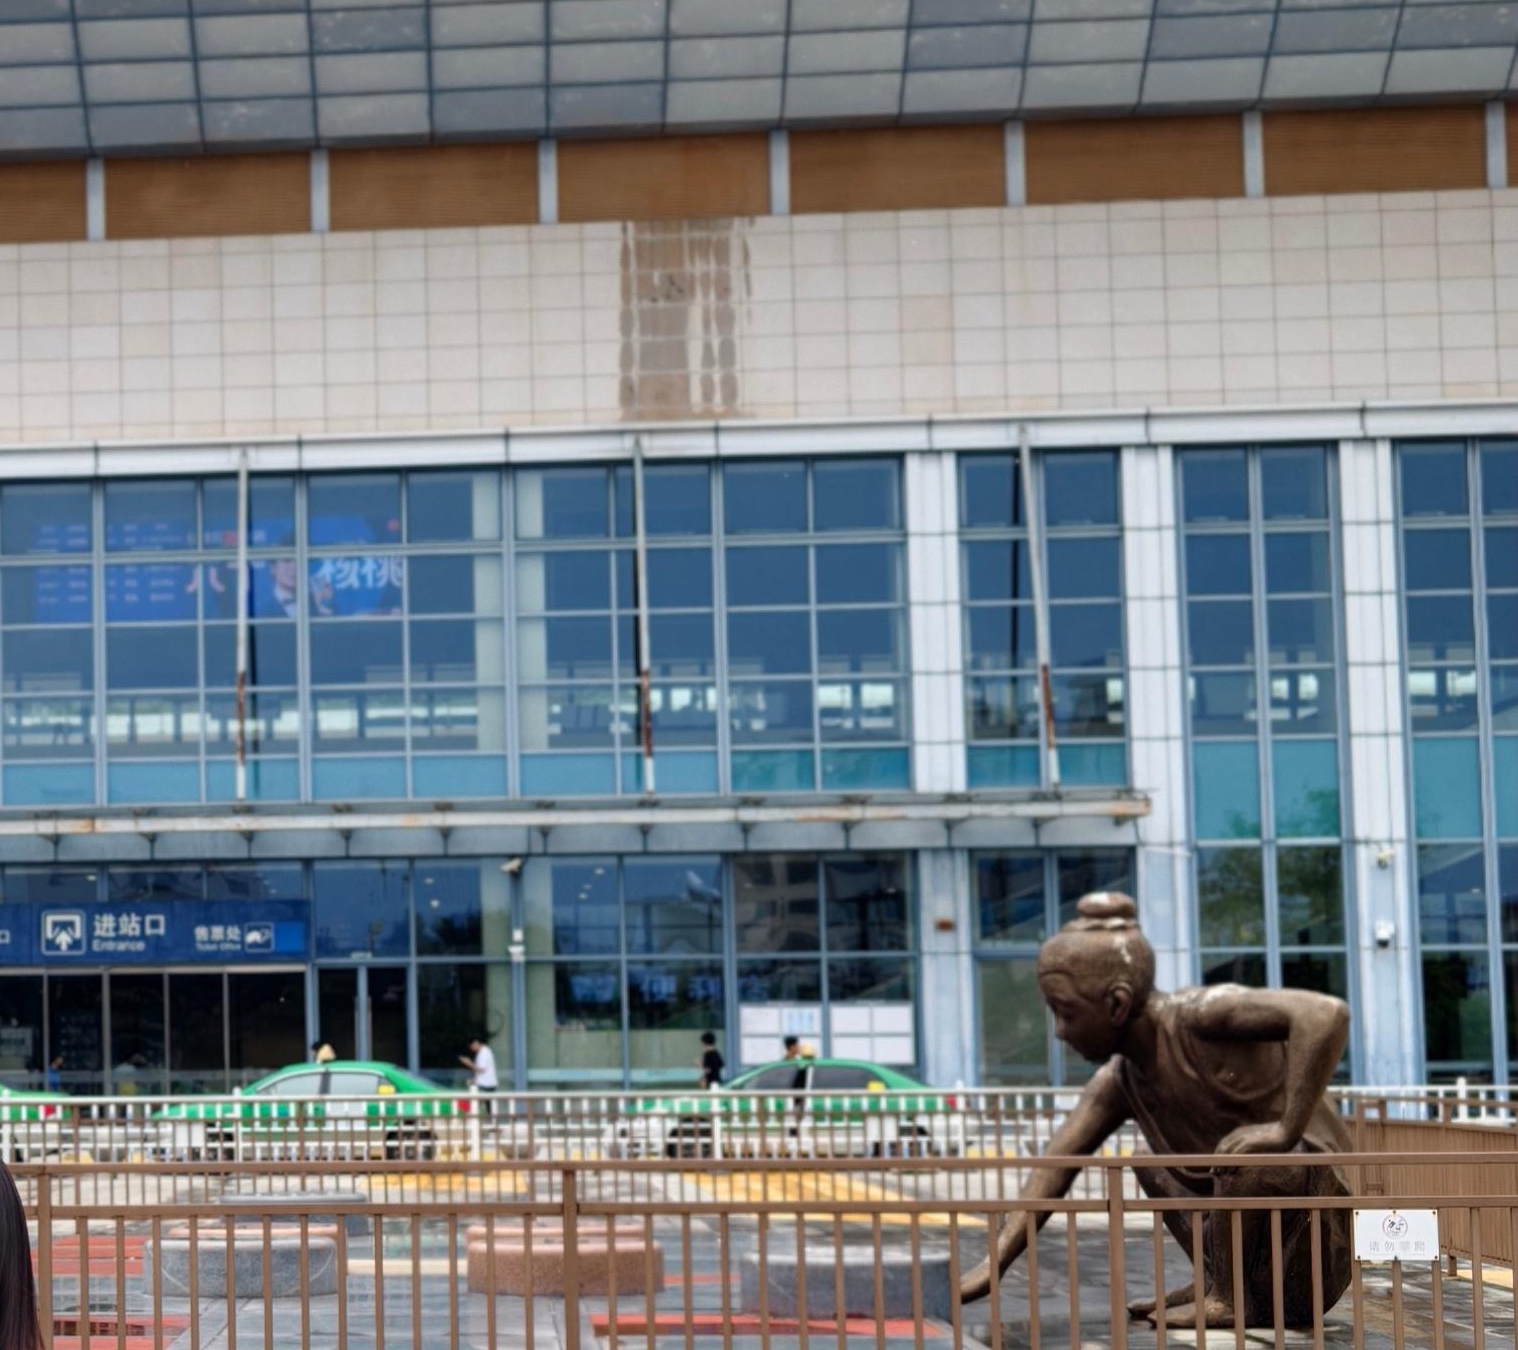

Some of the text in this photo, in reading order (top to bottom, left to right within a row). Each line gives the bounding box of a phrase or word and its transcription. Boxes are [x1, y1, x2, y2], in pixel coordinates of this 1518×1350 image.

[93, 913, 165, 937] 进站口
[92, 939, 146, 951] Entrance
